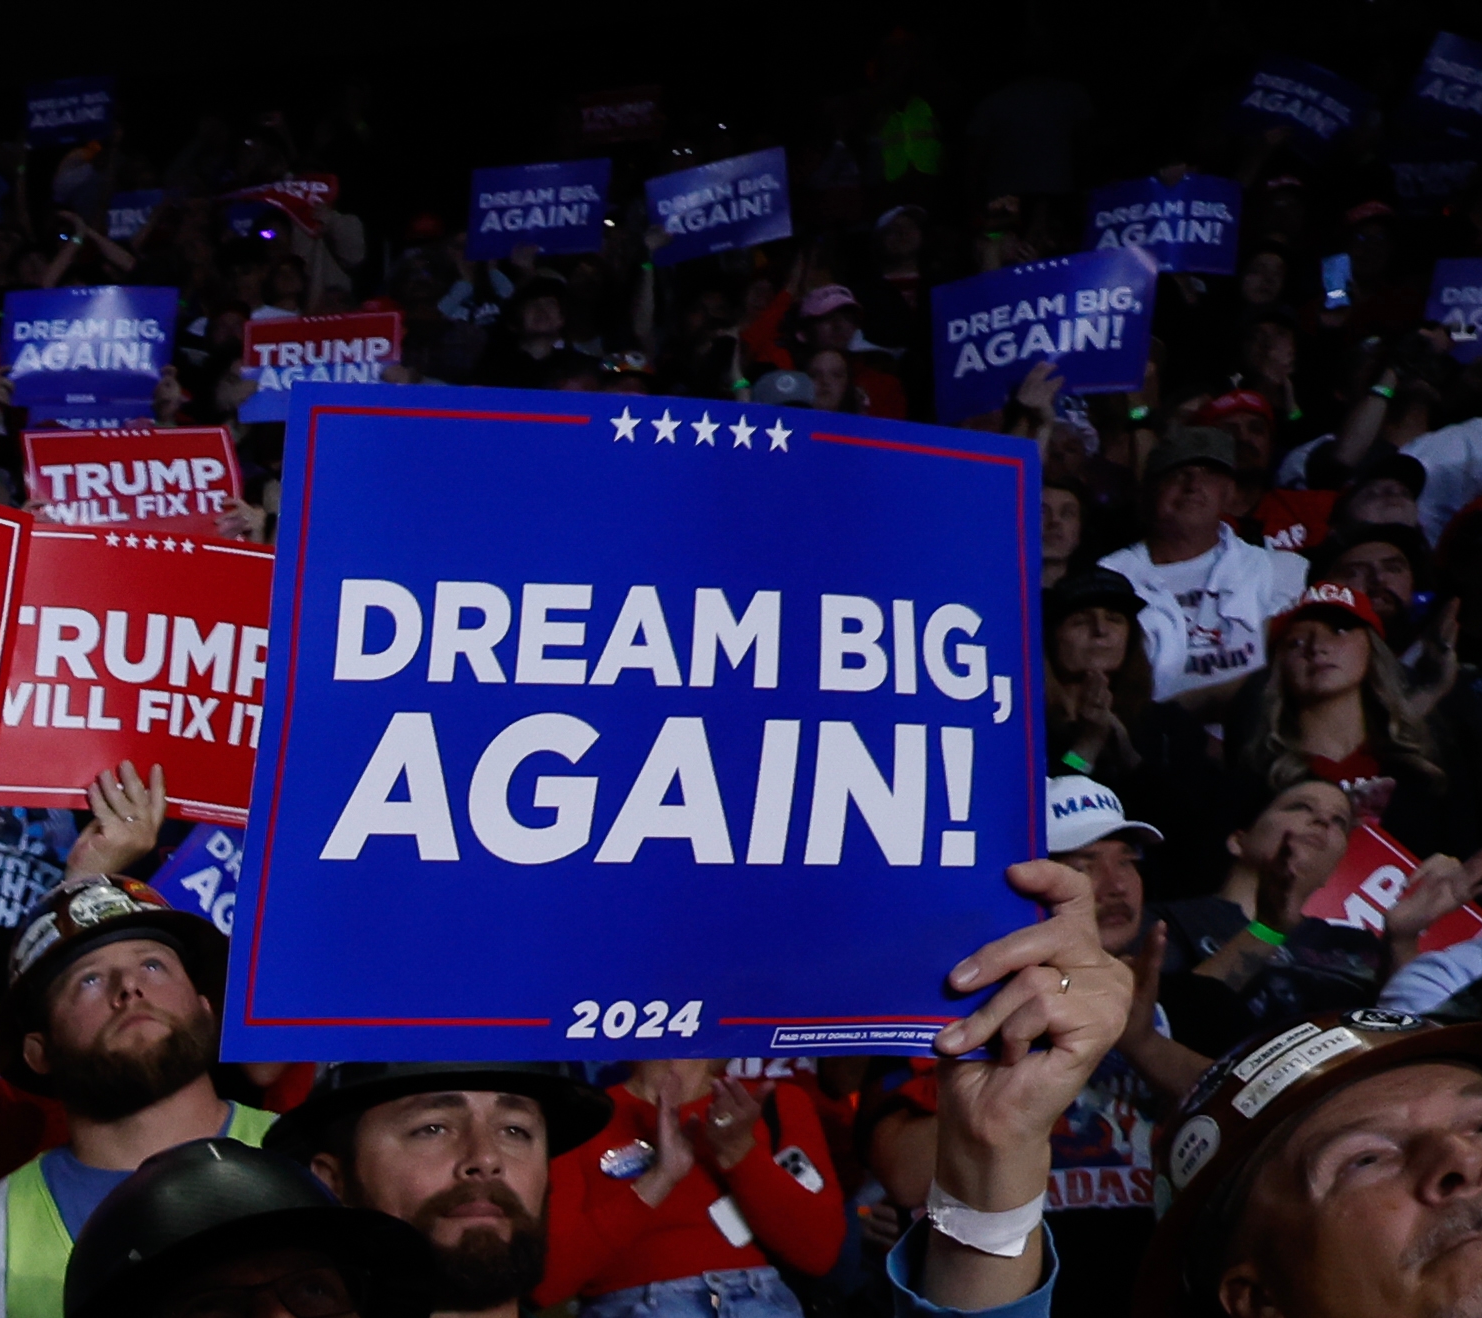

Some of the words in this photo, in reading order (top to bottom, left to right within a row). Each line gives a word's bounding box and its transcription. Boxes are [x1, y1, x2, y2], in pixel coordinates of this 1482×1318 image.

[478, 188, 548, 210] DREAM
[665, 191, 773, 236] AGAIN!
[1094, 200, 1185, 229] DREAM
[1189, 200, 1234, 223] BIG,
[479, 204, 589, 234] AGAIN!
[1096, 220, 1225, 251] AGAIN!
[12, 318, 115, 342] DREAM
[119, 317, 167, 343] BIG,
[946, 291, 1066, 345] DREAM
[1073, 285, 1143, 315] BIG,
[12, 341, 152, 373] AGAIN!
[252, 338, 392, 367] TRUMP
[953, 314, 1126, 379] AGAIN!
[257, 363, 385, 393] AGAIN!
[40, 456, 226, 501] TRUMP
[43, 499, 131, 526] WILL
[136, 493, 191, 519] FIX
[195, 489, 228, 515] IT
[332, 578, 781, 689] DREAM
[818, 594, 1013, 724] BIG,
[136, 687, 220, 744] FIX
[318, 711, 979, 868] AGAIN!
[564, 1000, 705, 1040] 2024
